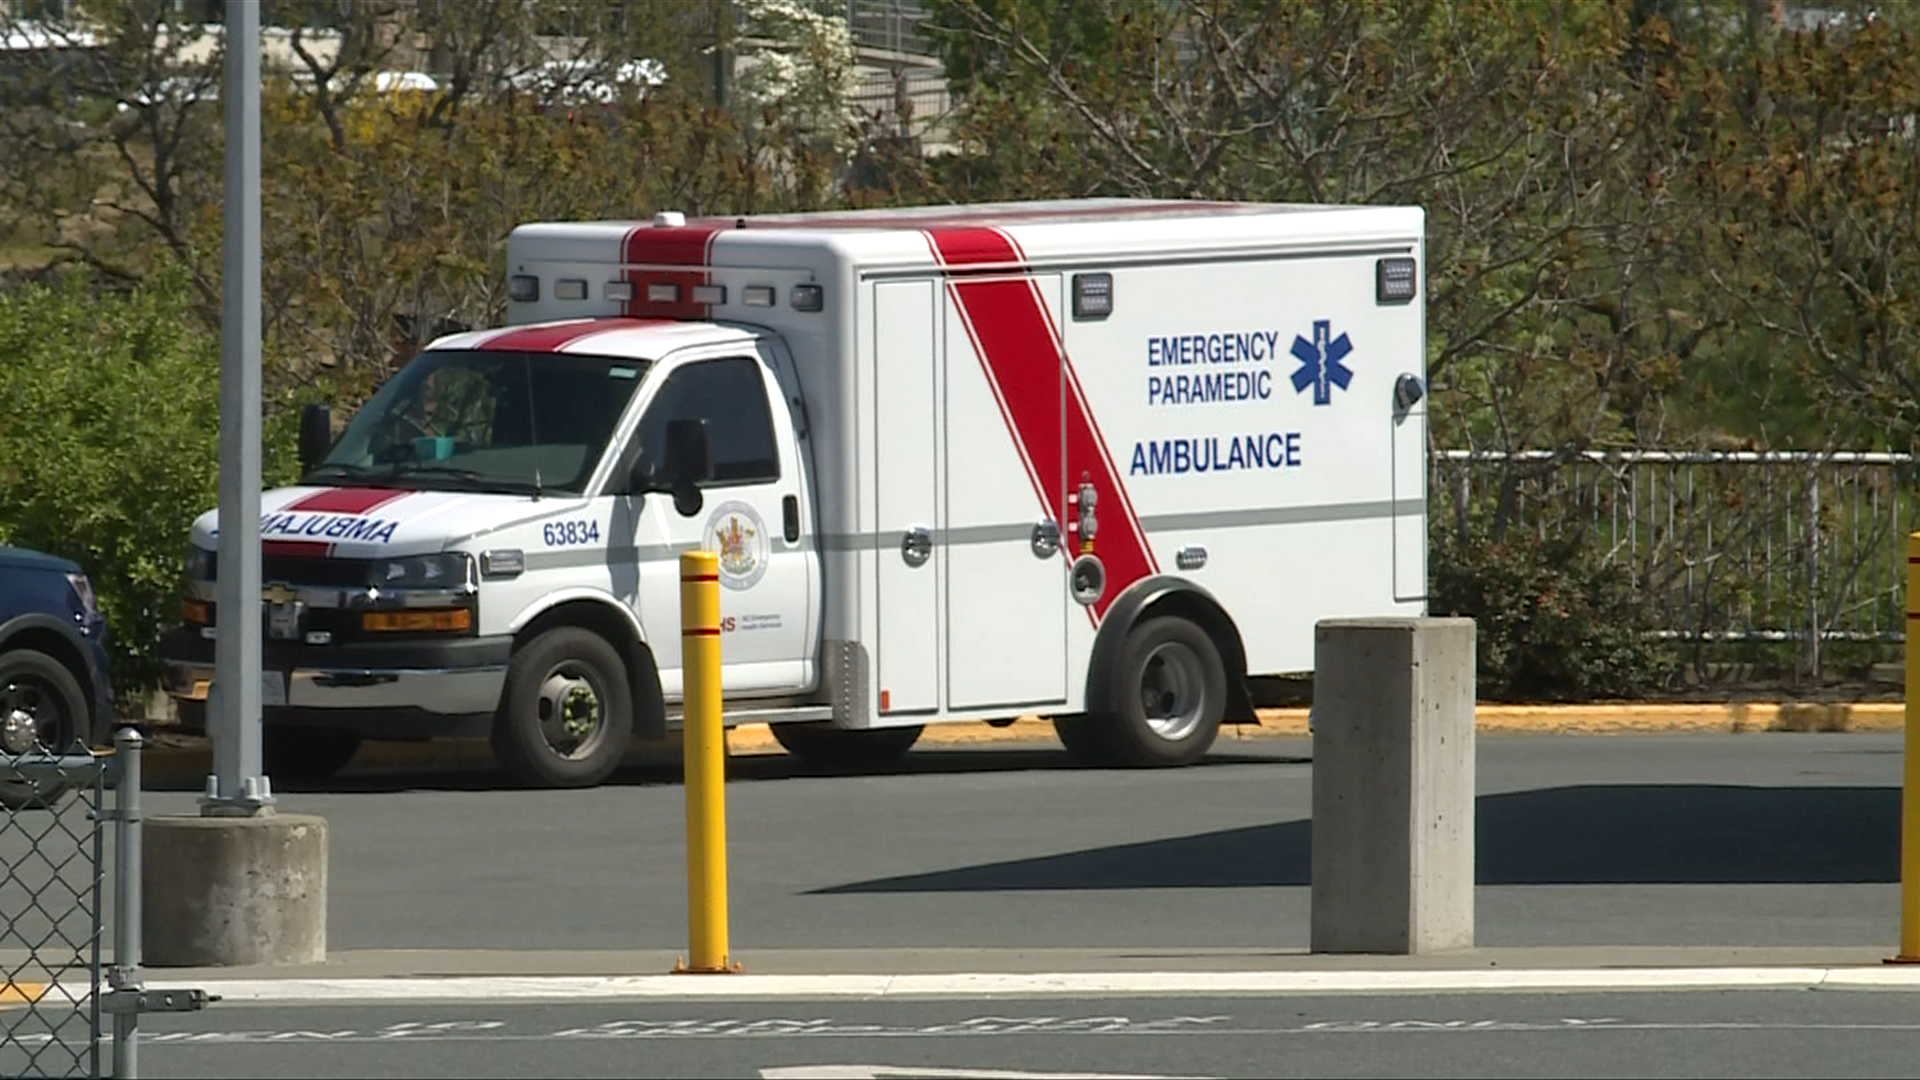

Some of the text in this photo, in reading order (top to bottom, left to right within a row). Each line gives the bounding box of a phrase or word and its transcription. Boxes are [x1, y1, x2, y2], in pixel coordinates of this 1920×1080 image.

[1148, 331, 1279, 366] EMERGENCY
[1148, 370, 1271, 405] PARAMEDIC
[1130, 432, 1302, 476] AMBULANCE
[543, 519, 600, 546] 63834
